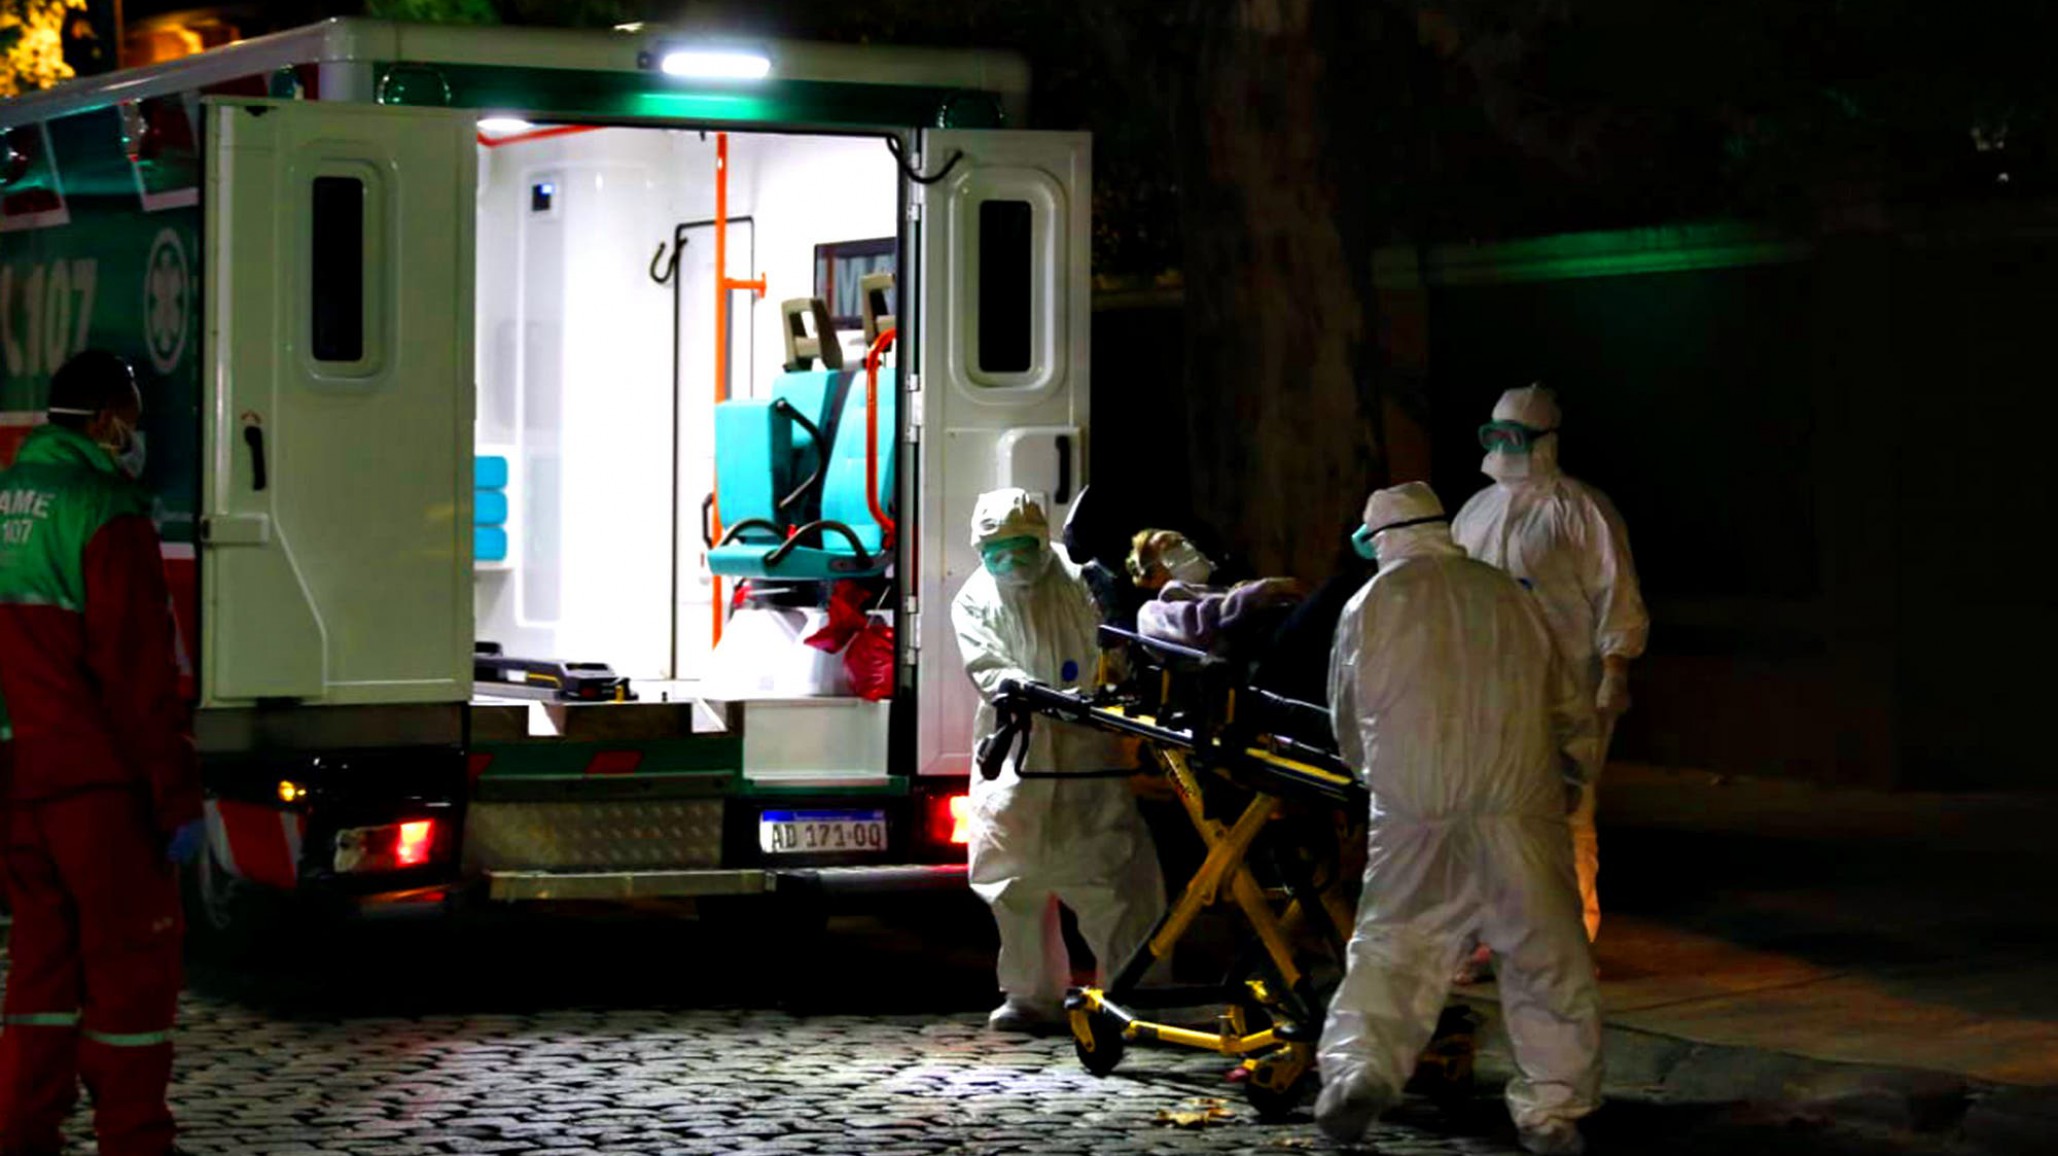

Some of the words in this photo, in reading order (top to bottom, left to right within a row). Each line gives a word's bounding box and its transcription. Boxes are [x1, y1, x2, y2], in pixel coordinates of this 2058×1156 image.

[23, 258, 98, 376] 107
[3, 519, 33, 545] 107
[772, 824, 797, 848] AD
